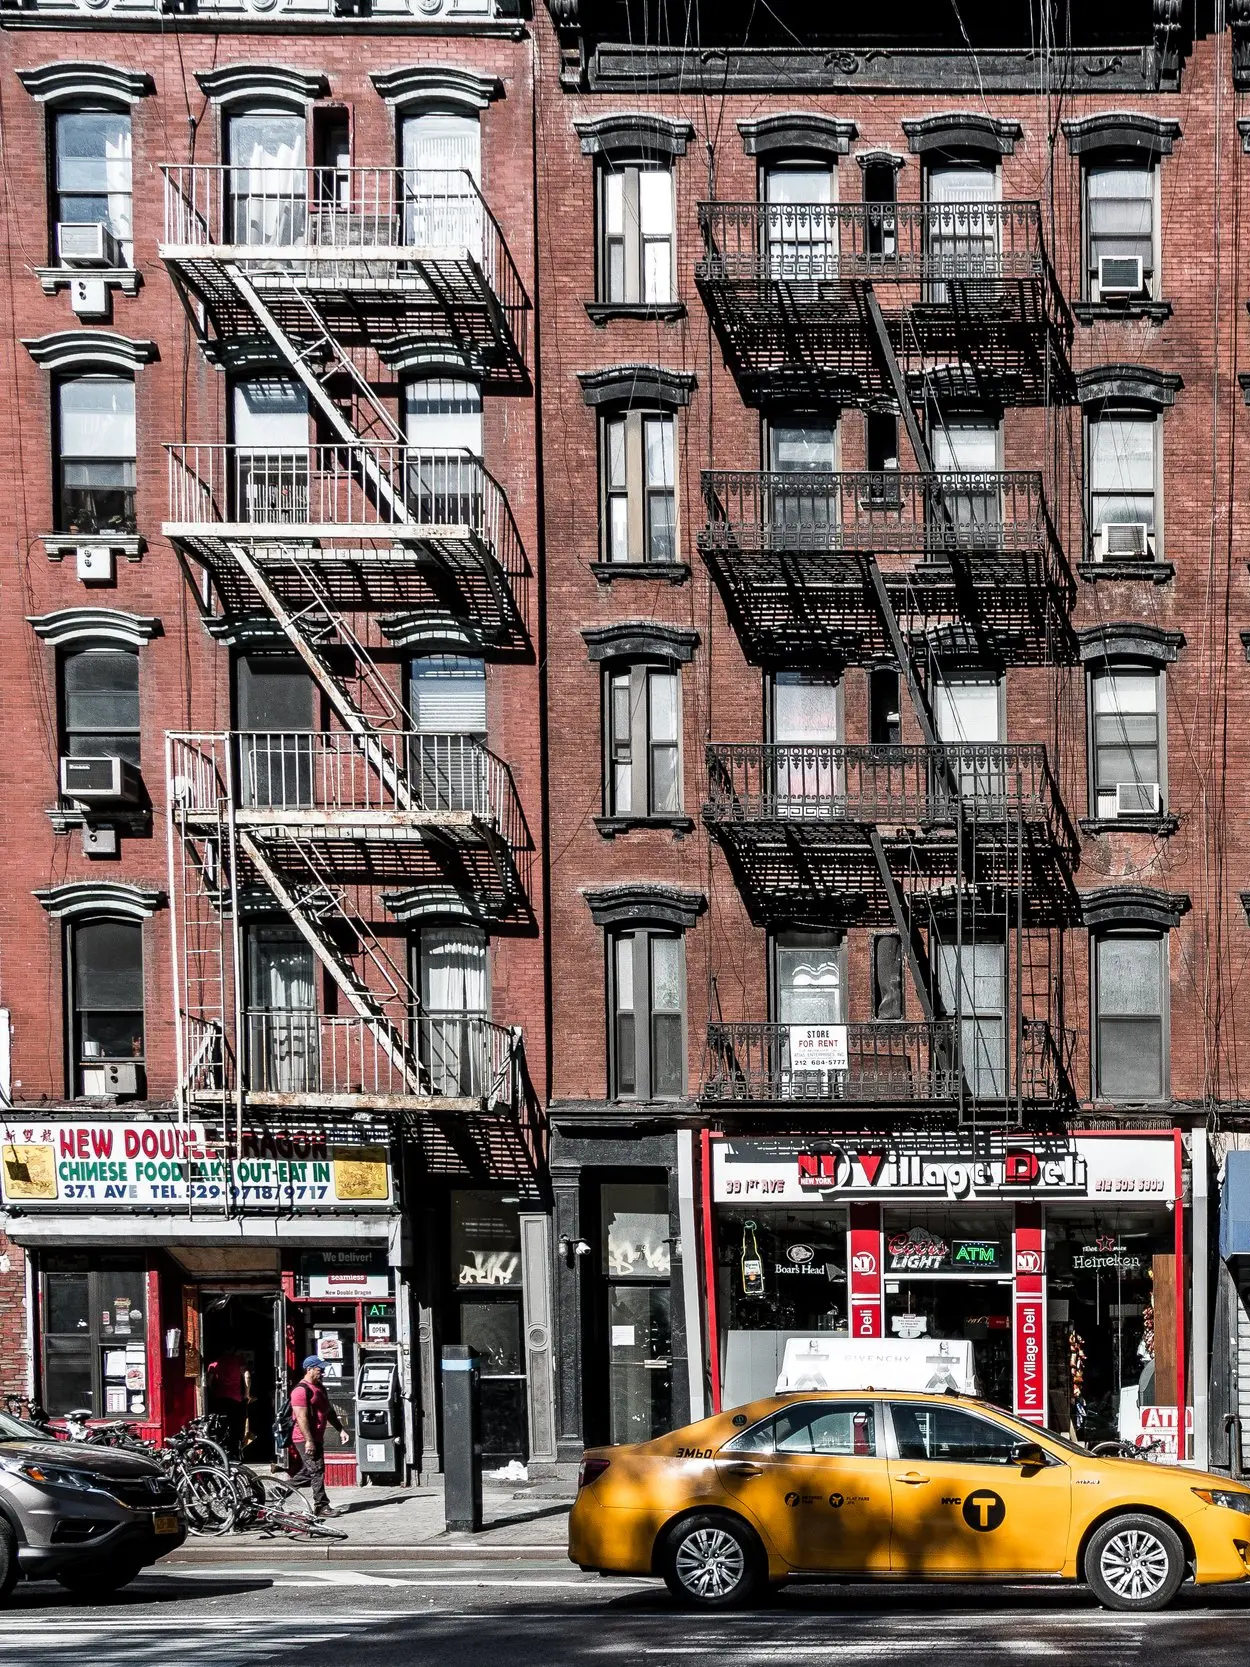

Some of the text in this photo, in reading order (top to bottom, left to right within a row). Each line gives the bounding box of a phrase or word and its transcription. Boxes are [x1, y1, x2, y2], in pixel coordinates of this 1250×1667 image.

[807, 1030, 829, 1038] STORE
[60, 1129, 113, 1159] NEW
[798, 1151, 838, 1176] NY
[856, 1147, 1088, 1193] Village Deli
[58, 1161, 128, 1182] CHINESE
[135, 1161, 182, 1182] FOOD
[189, 1162, 232, 1182] TAKE
[313, 1162, 330, 1182] IN
[104, 1185, 138, 1198] AVE
[761, 1180, 785, 1194] AVE
[887, 1234, 949, 1255] Coors
[322, 1252, 373, 1262] We Deliver!
[956, 1248, 994, 1261] ATM
[1017, 1254, 1036, 1267] NY
[1072, 1254, 1141, 1269] Heineken
[775, 1263, 825, 1275] Boar's Head
[853, 1256, 871, 1268] NY
[890, 1255, 945, 1269] LIGHT
[331, 1273, 365, 1281] seamless
[860, 1310, 873, 1335] Deli
[844, 1355, 912, 1363] GIVENCHY
[1023, 1308, 1038, 1405] NY Village Deli
[973, 1498, 996, 1526] T
